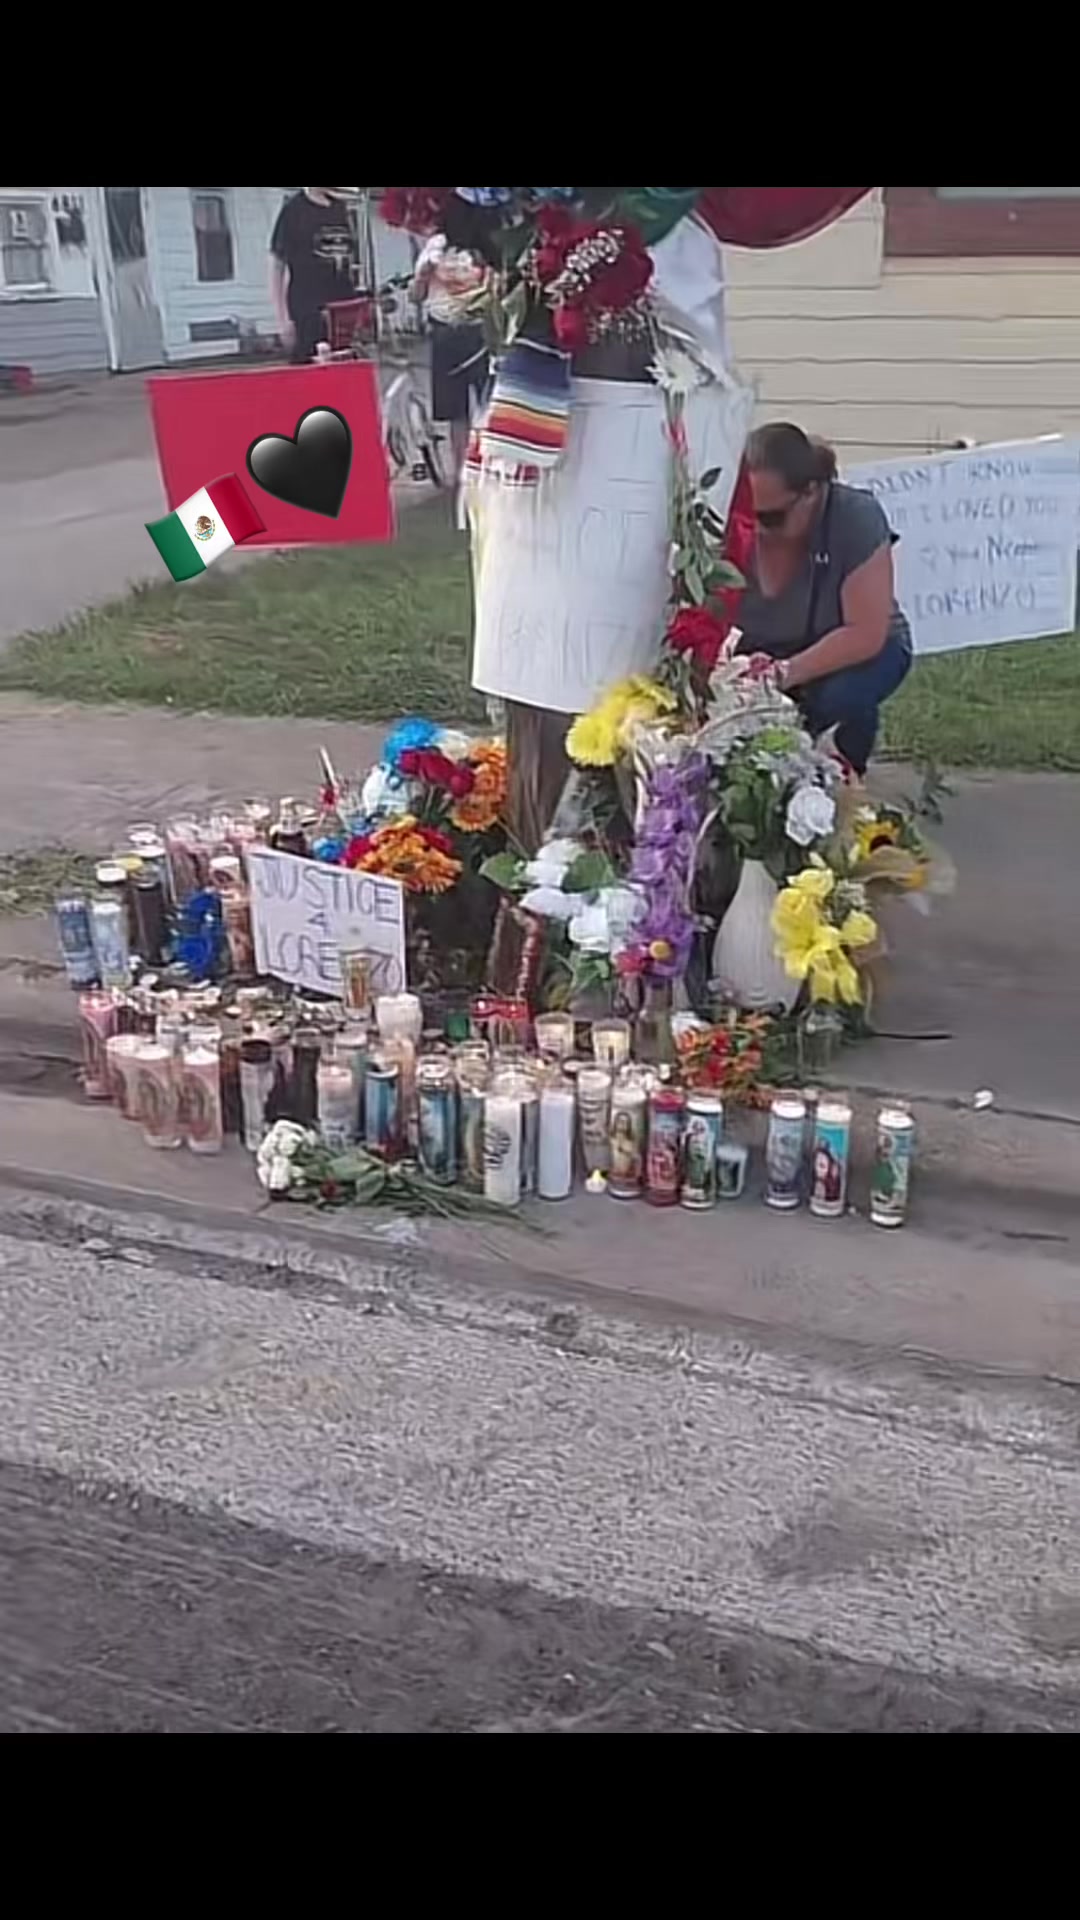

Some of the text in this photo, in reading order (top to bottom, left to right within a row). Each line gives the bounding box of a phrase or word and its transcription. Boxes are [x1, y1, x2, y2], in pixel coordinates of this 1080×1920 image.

[941, 492, 1015, 521] LOVED
[914, 580, 1037, 620] LORENZO
[252, 852, 401, 925] JUSTICE
[307, 912, 329, 936] 4
[262, 924, 403, 993] LOREZO
